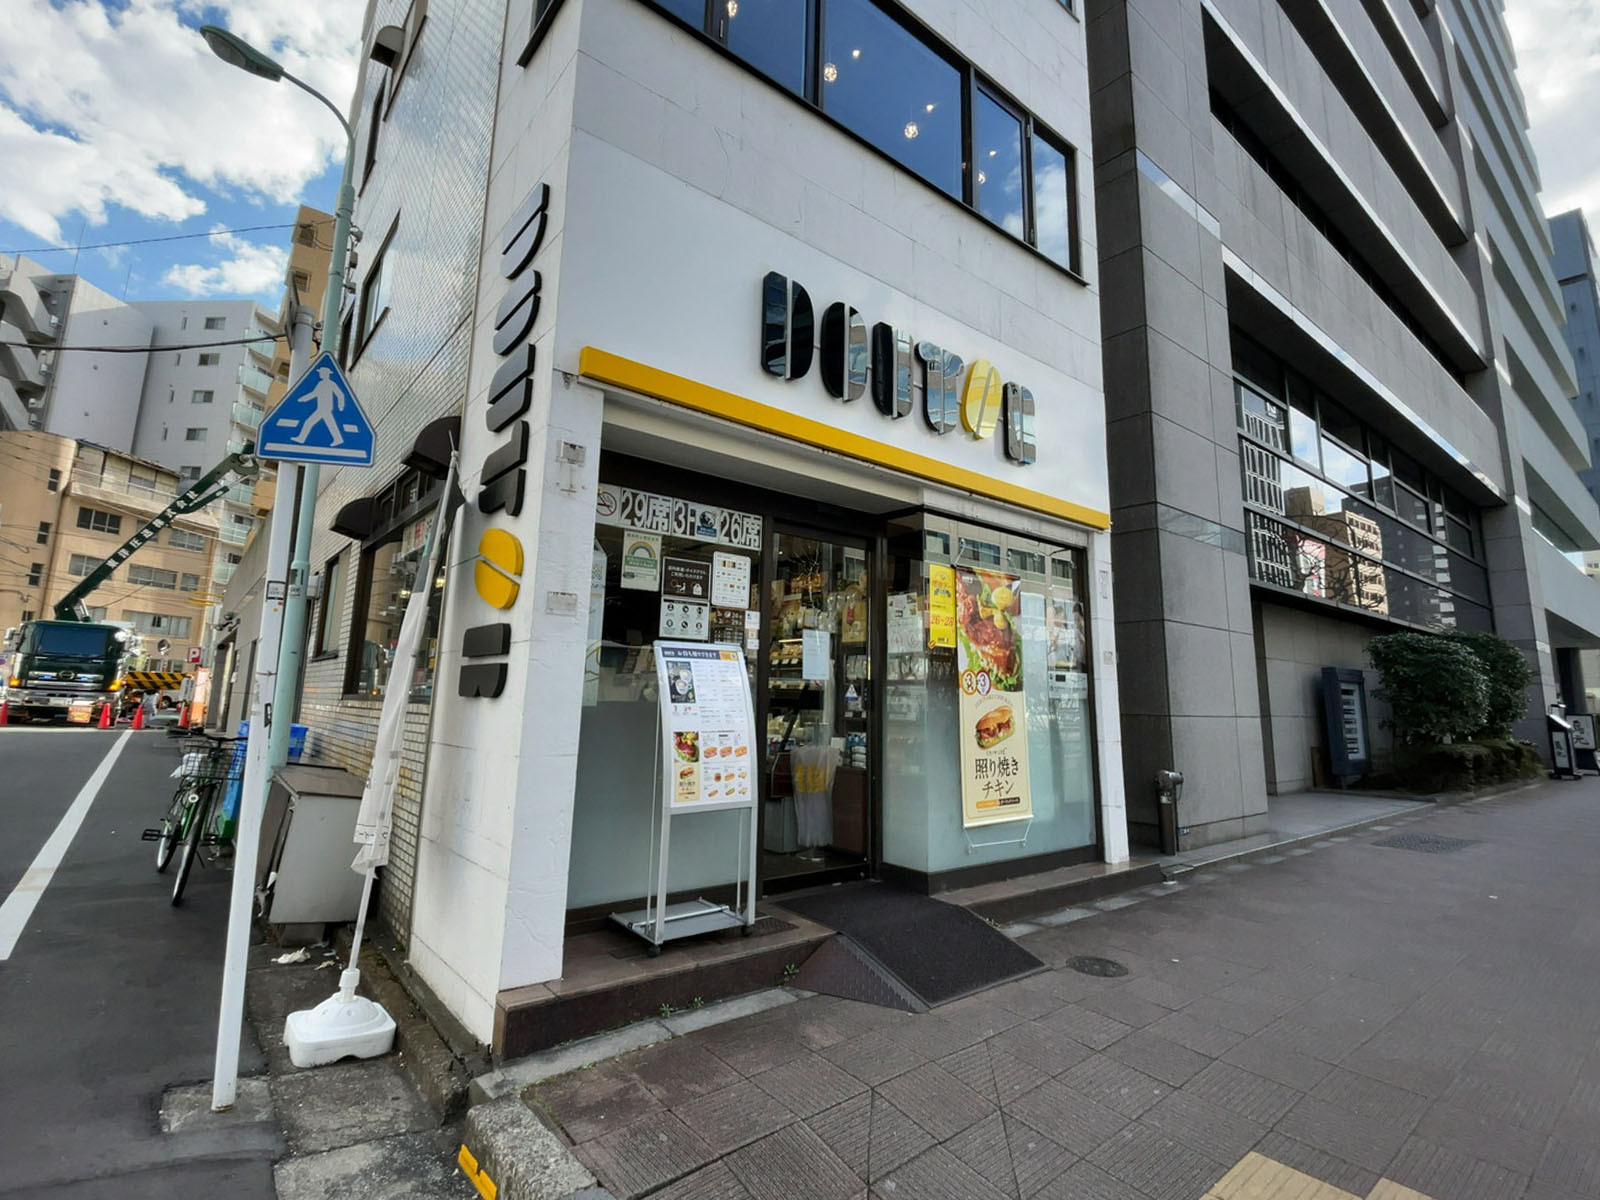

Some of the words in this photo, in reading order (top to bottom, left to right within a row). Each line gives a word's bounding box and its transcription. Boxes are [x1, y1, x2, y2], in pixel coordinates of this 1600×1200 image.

[761, 270, 1036, 466] DOUTOR
[458, 182, 549, 698] DOUTOR
[621, 489, 671, 533] 29席
[720, 511, 762, 549] 26席
[189, 647, 200, 662] P
[975, 756, 1019, 779] 照り焼き
[982, 779, 1014, 799] チキン
